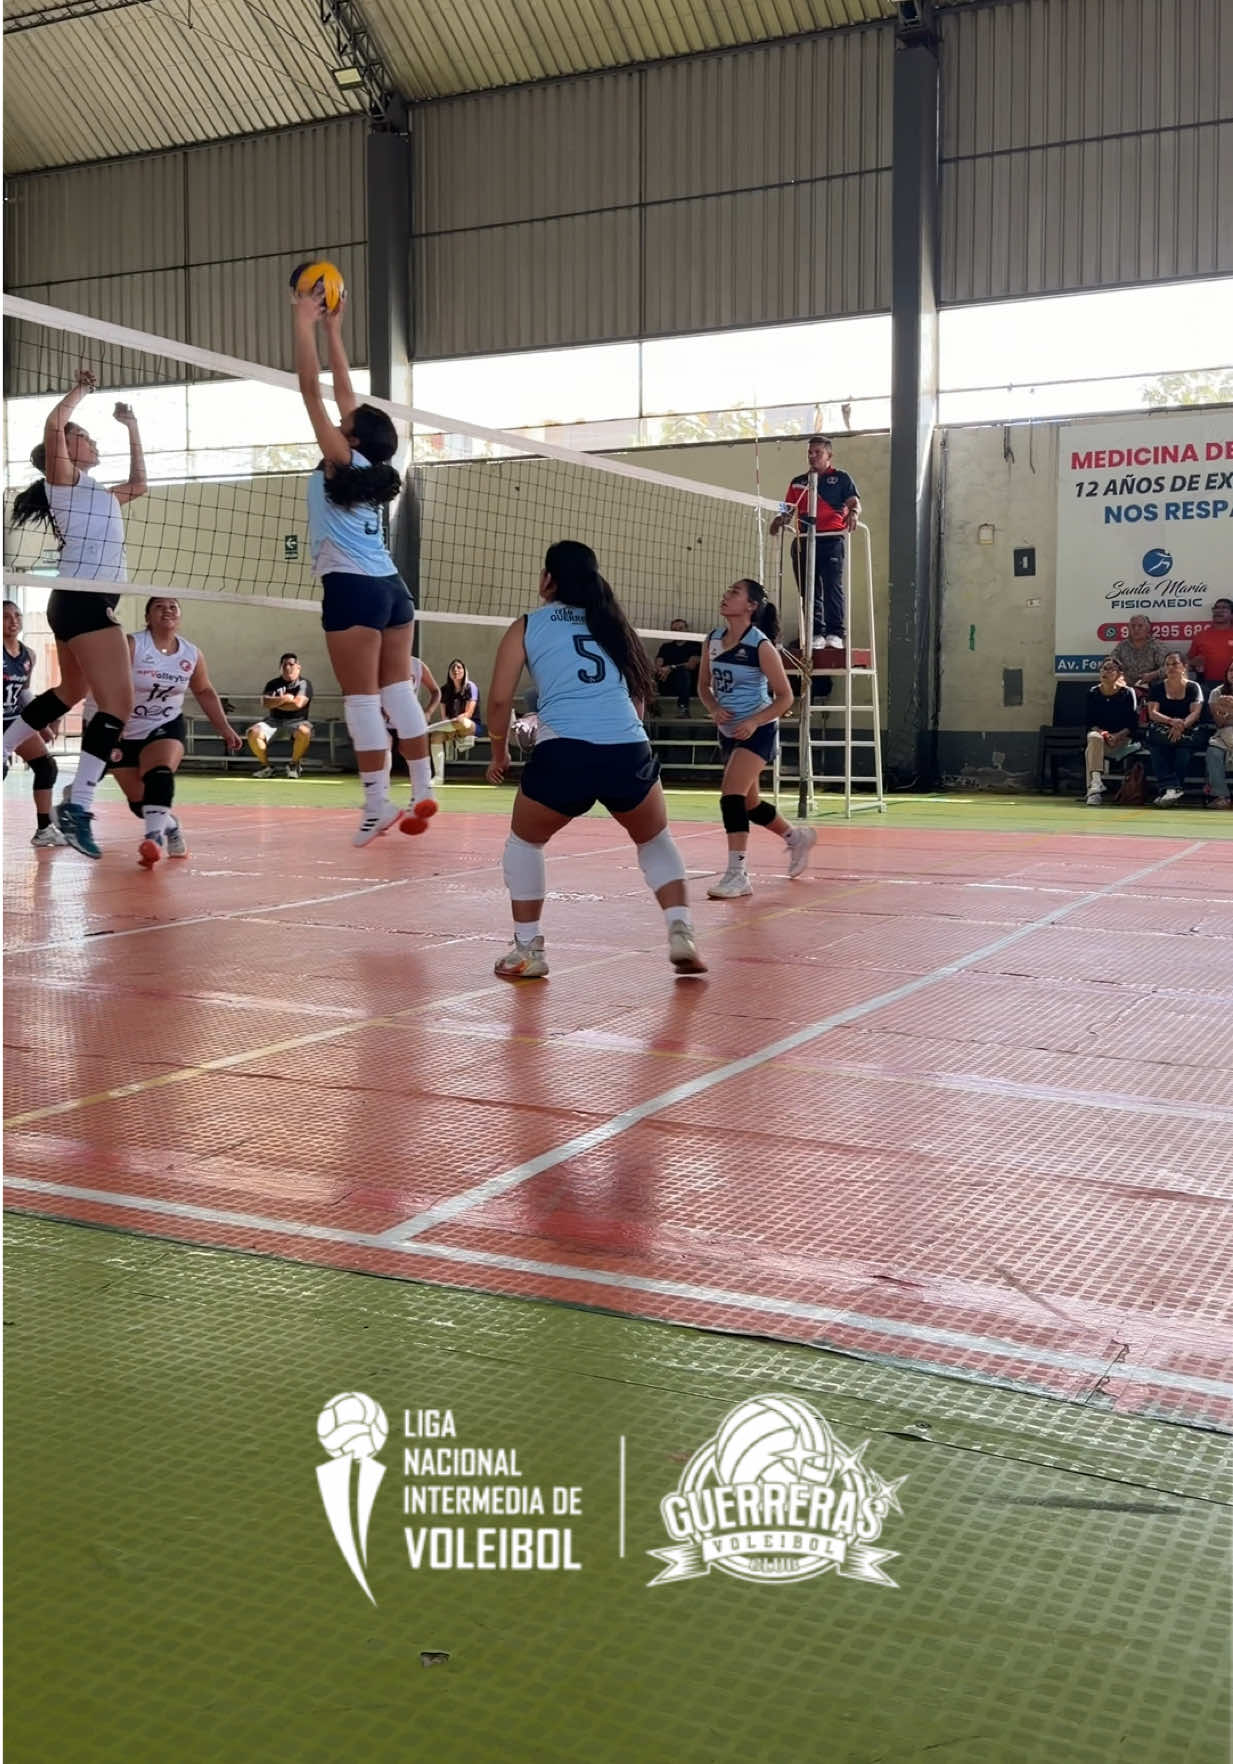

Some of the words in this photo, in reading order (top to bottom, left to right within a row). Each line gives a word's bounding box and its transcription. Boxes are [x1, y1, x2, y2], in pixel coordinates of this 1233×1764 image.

[1071, 443, 1199, 470] MEDICINA
[1075, 481, 1099, 497] 12
[1103, 474, 1165, 497] AÑOS
[1169, 474, 1201, 492] DE
[1205, 472, 1233, 490] EX
[1104, 503, 1158, 524] NOS
[1165, 500, 1233, 521] RESP
[1105, 580, 1150, 599] Santa
[1111, 598, 1203, 609] FISIOMEDIC
[1152, 625, 1180, 638] 295
[572, 634, 607, 684] 5
[1057, 659, 1079, 671] Av.
